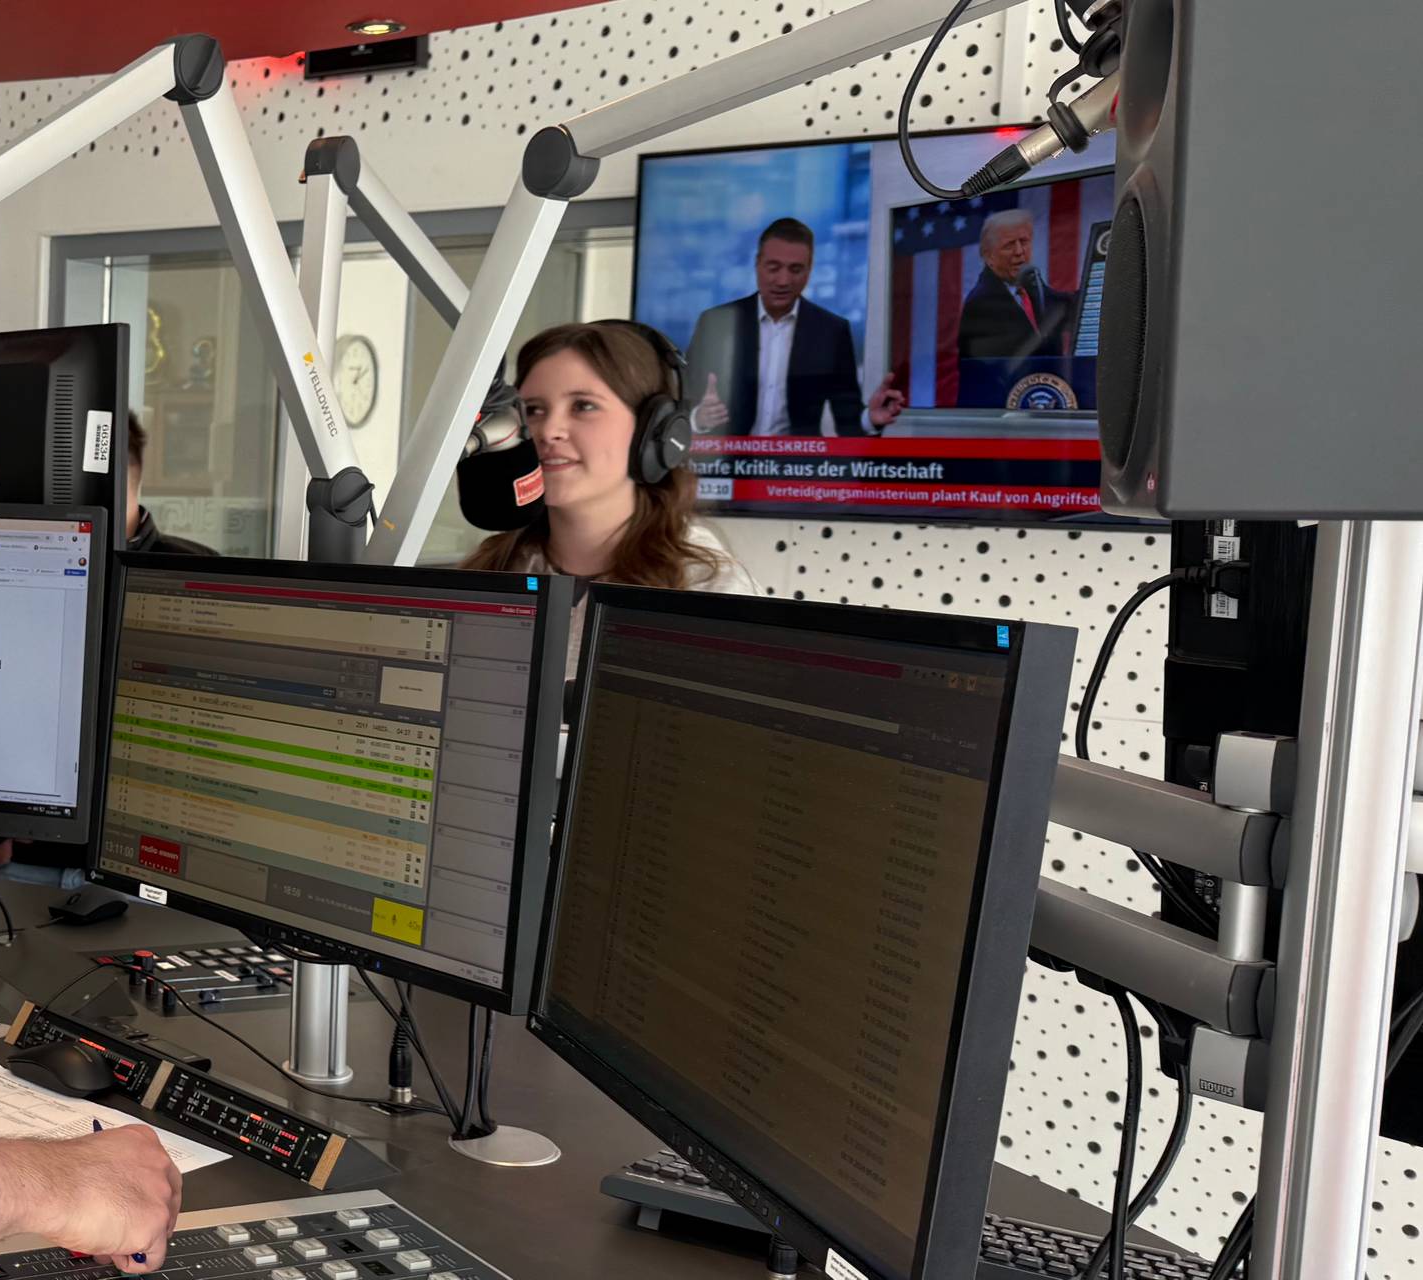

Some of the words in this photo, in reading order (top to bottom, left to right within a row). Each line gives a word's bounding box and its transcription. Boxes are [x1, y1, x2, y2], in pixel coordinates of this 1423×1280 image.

[309, 366, 338, 438] YELLOWTEC
[726, 440, 826, 453] HANDELSKRIEG
[734, 460, 778, 475] Kritik
[783, 464, 814, 476] aus
[817, 462, 844, 477] der
[851, 461, 944, 480] Wirtschaft
[767, 484, 929, 501] Verteidigungsministerium
[932, 489, 966, 503] plant
[970, 490, 1002, 503] Kauf
[1004, 493, 1030, 504] von
